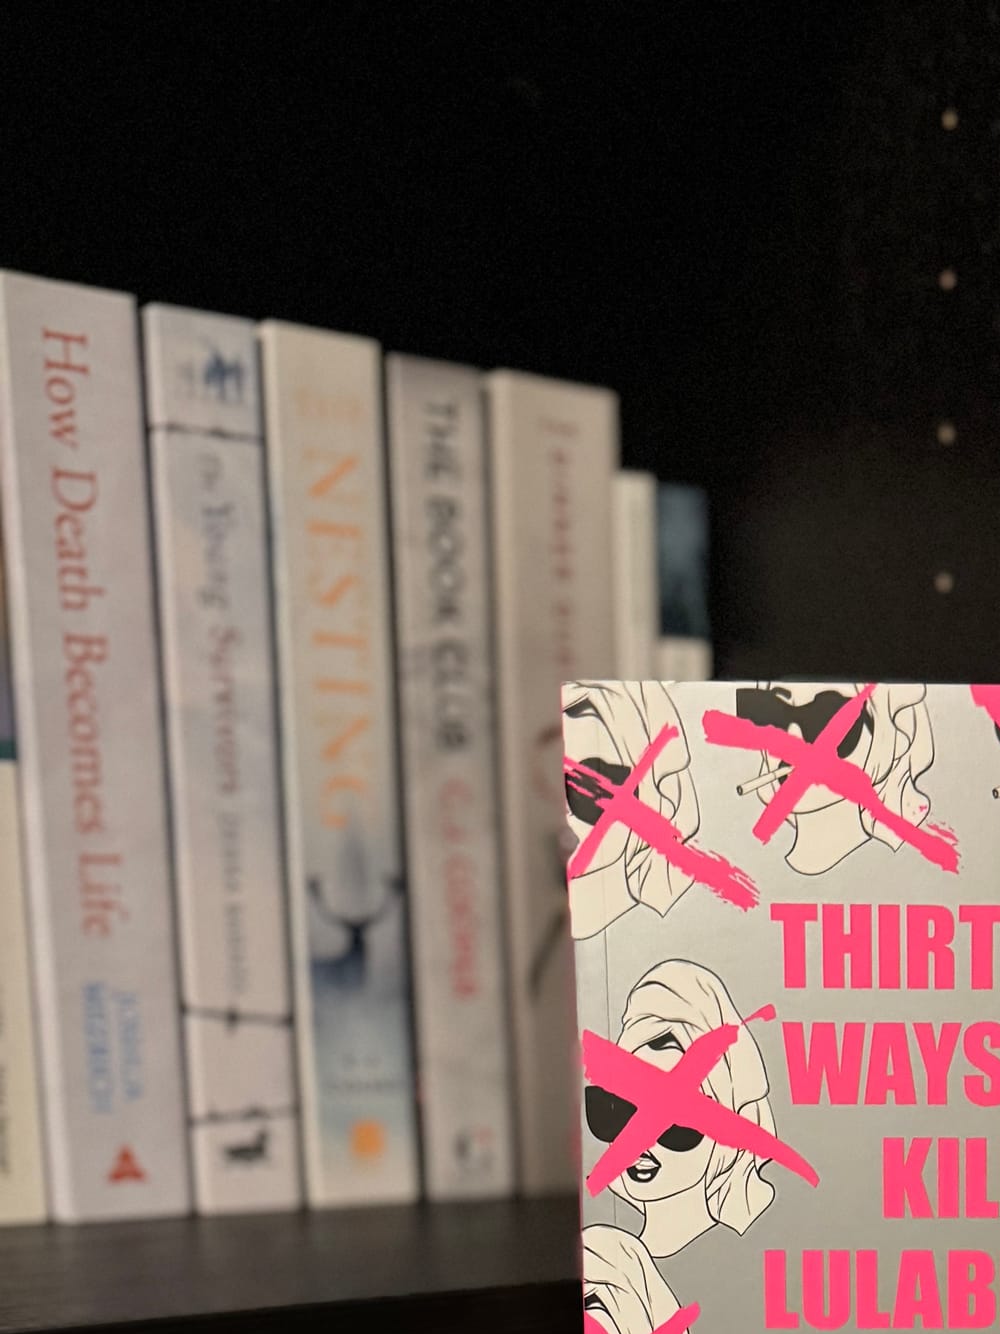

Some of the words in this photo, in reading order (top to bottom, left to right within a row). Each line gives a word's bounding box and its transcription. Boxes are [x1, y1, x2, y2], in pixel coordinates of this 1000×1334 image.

[42, 325, 90, 452] How
[424, 400, 465, 480] THE
[51, 463, 107, 614] Death
[427, 494, 470, 626] BOOK
[306, 448, 375, 830] NESTING
[433, 637, 477, 755] CLUB
[62, 627, 109, 853] Becomes
[78, 852, 130, 938] Life
